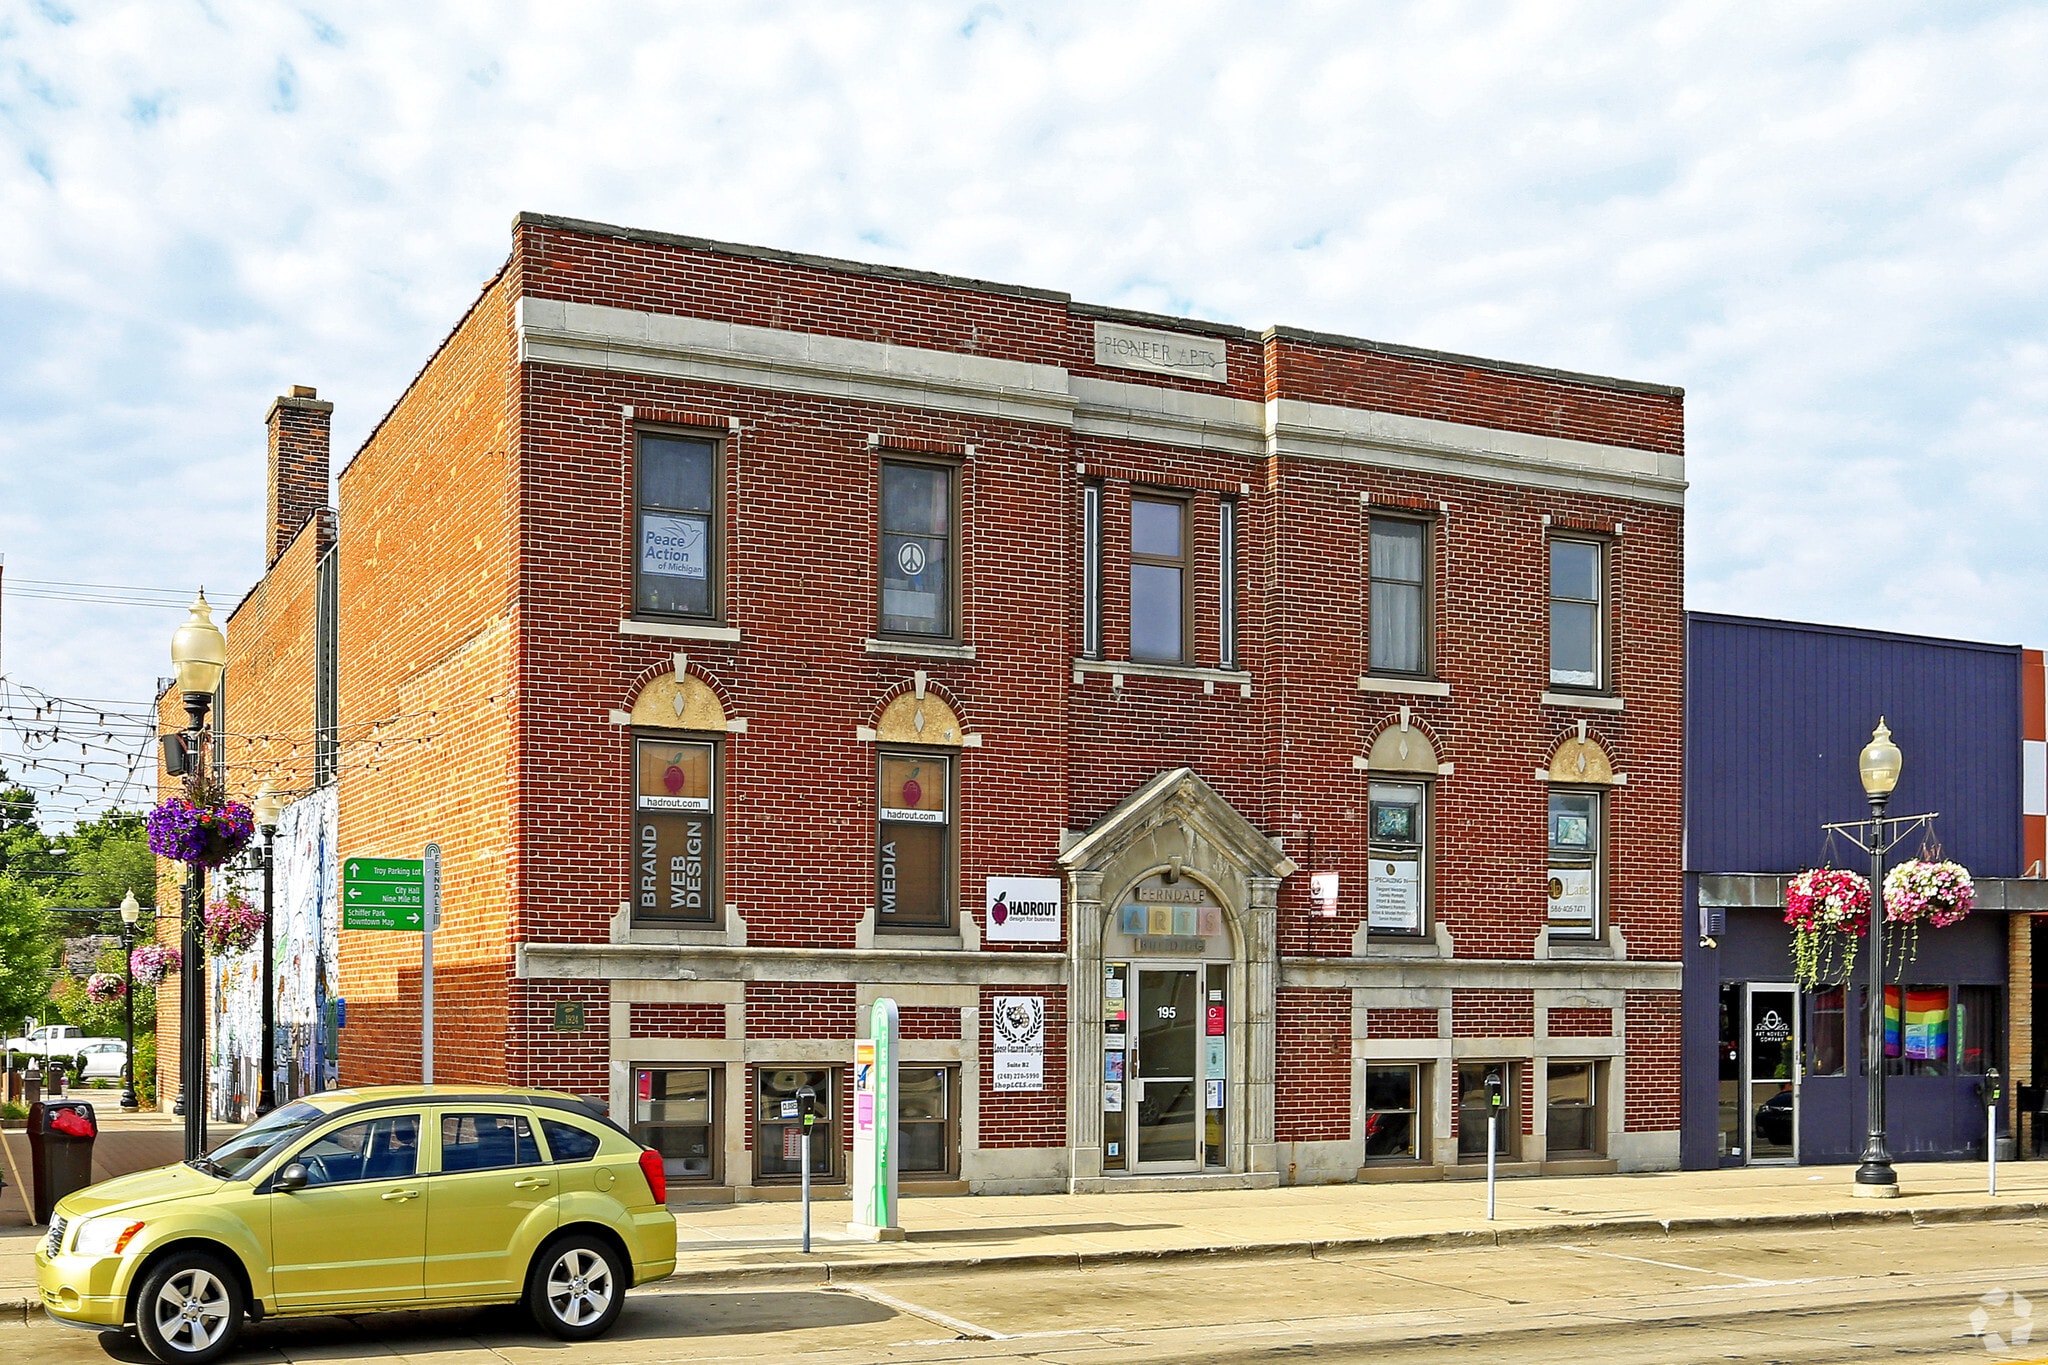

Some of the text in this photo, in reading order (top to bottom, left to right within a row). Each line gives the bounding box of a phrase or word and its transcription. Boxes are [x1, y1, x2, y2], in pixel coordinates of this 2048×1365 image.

[1104, 336, 1215, 364] PIONEER APTS
[645, 531, 685, 547] Peace
[645, 546, 689, 562] Action
[668, 563, 702, 574] Michigan
[647, 797, 701, 808] hadrout.com
[886, 810, 936, 821] hadrout.com
[374, 867, 386, 876] Troy
[387, 867, 410, 877] Parking
[641, 824, 657, 908] BRAND
[686, 821, 702, 908] DESIGN
[670, 855, 686, 908] WEB
[882, 841, 896, 913] MEDIA
[395, 886, 406, 895] City
[1141, 888, 1206, 901] FERNDALE
[372, 909, 386, 917] Park
[1009, 901, 1058, 916] HADROUT
[382, 918, 395, 926] Map
[1128, 910, 1215, 931] ARTS
[1156, 1006, 1177, 1019] 195
[880, 1031, 888, 1163] FERNDALE
